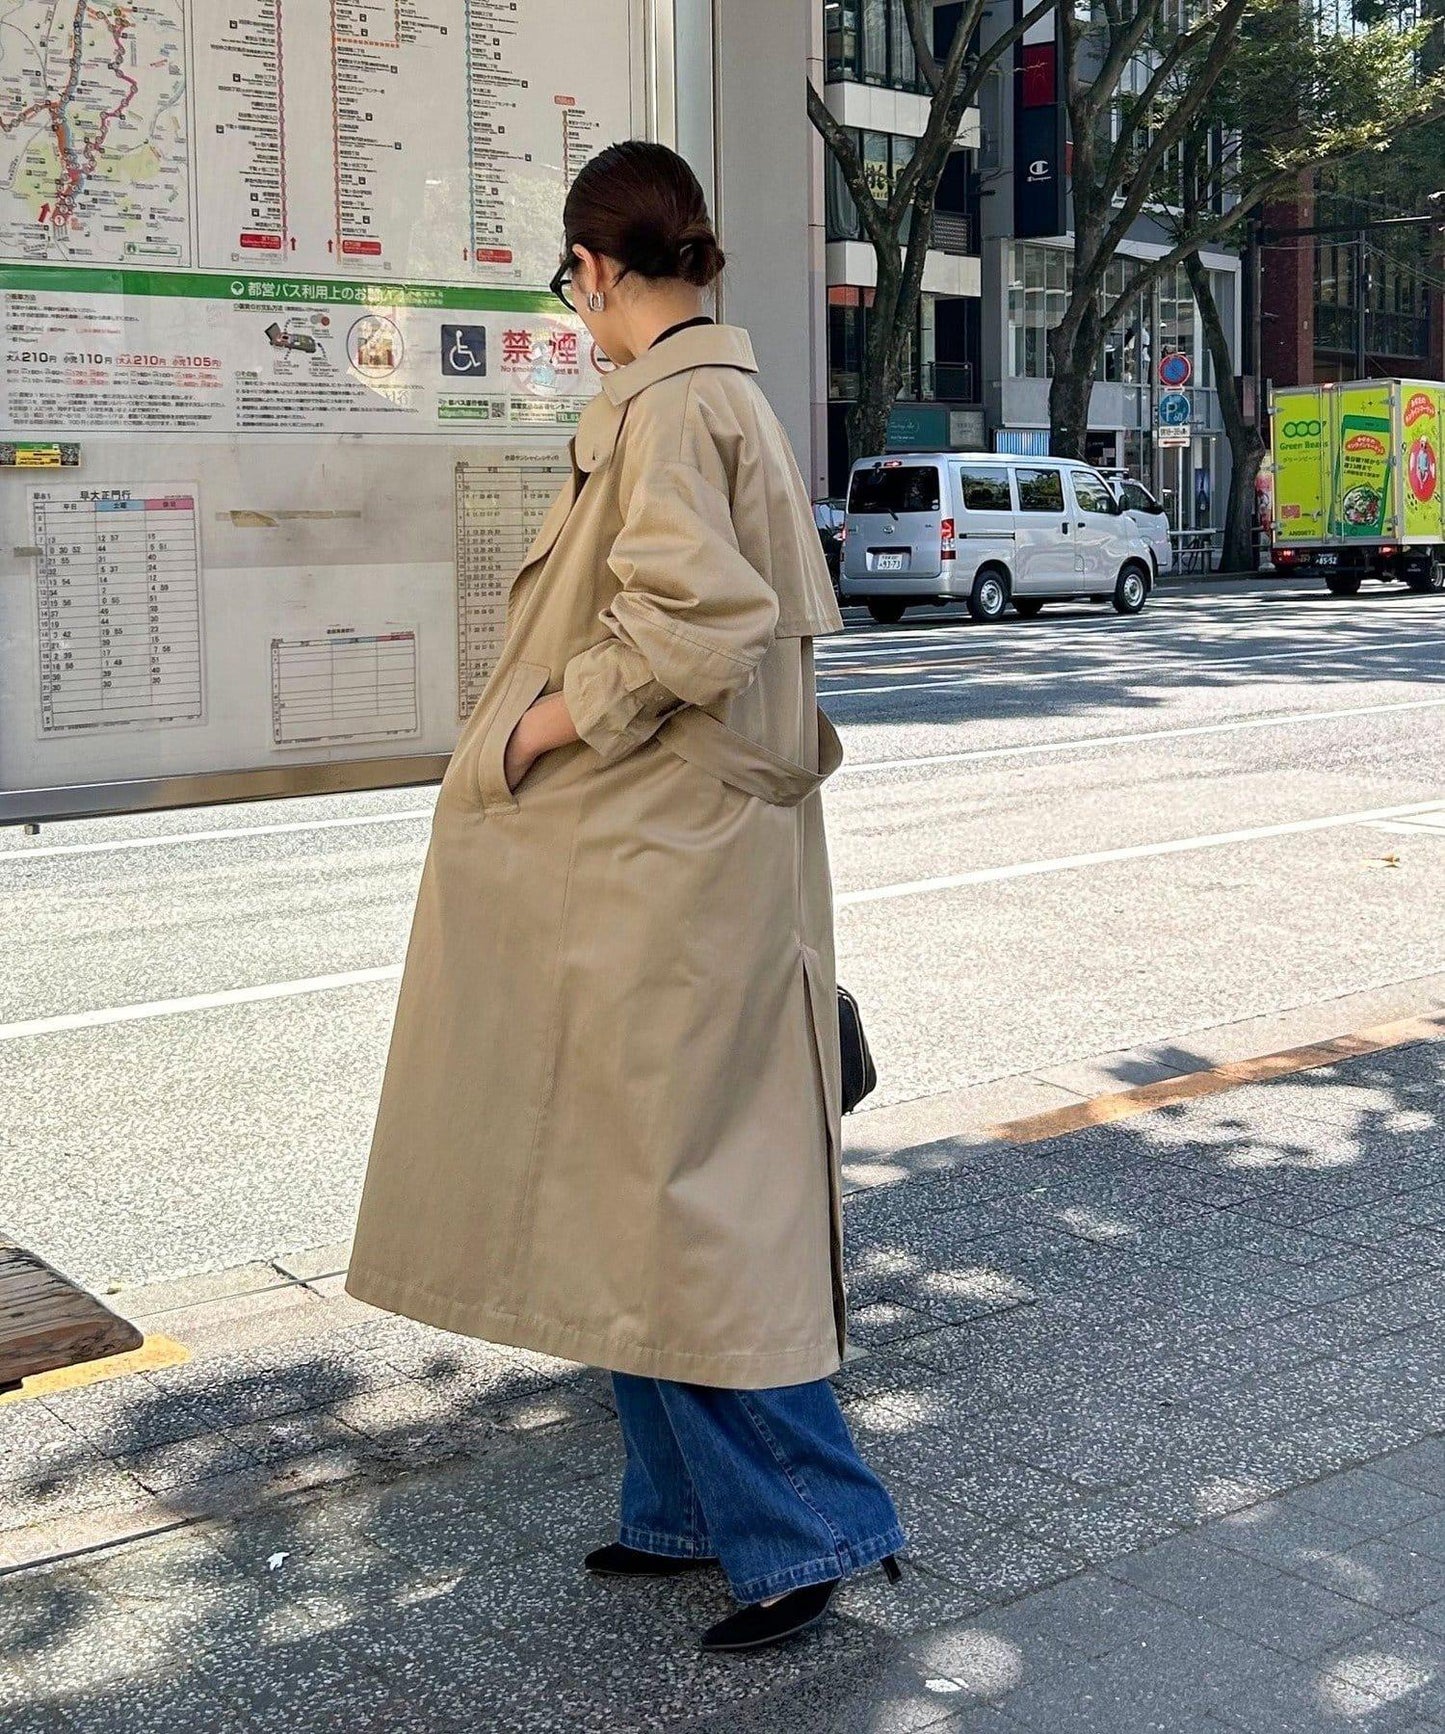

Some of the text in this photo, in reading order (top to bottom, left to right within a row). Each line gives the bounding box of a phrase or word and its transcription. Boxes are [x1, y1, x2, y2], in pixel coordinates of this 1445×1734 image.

[1166, 401, 1178, 422] P
[1280, 442, 1303, 450] Green
[80, 490, 131, 500] 早大正門行
